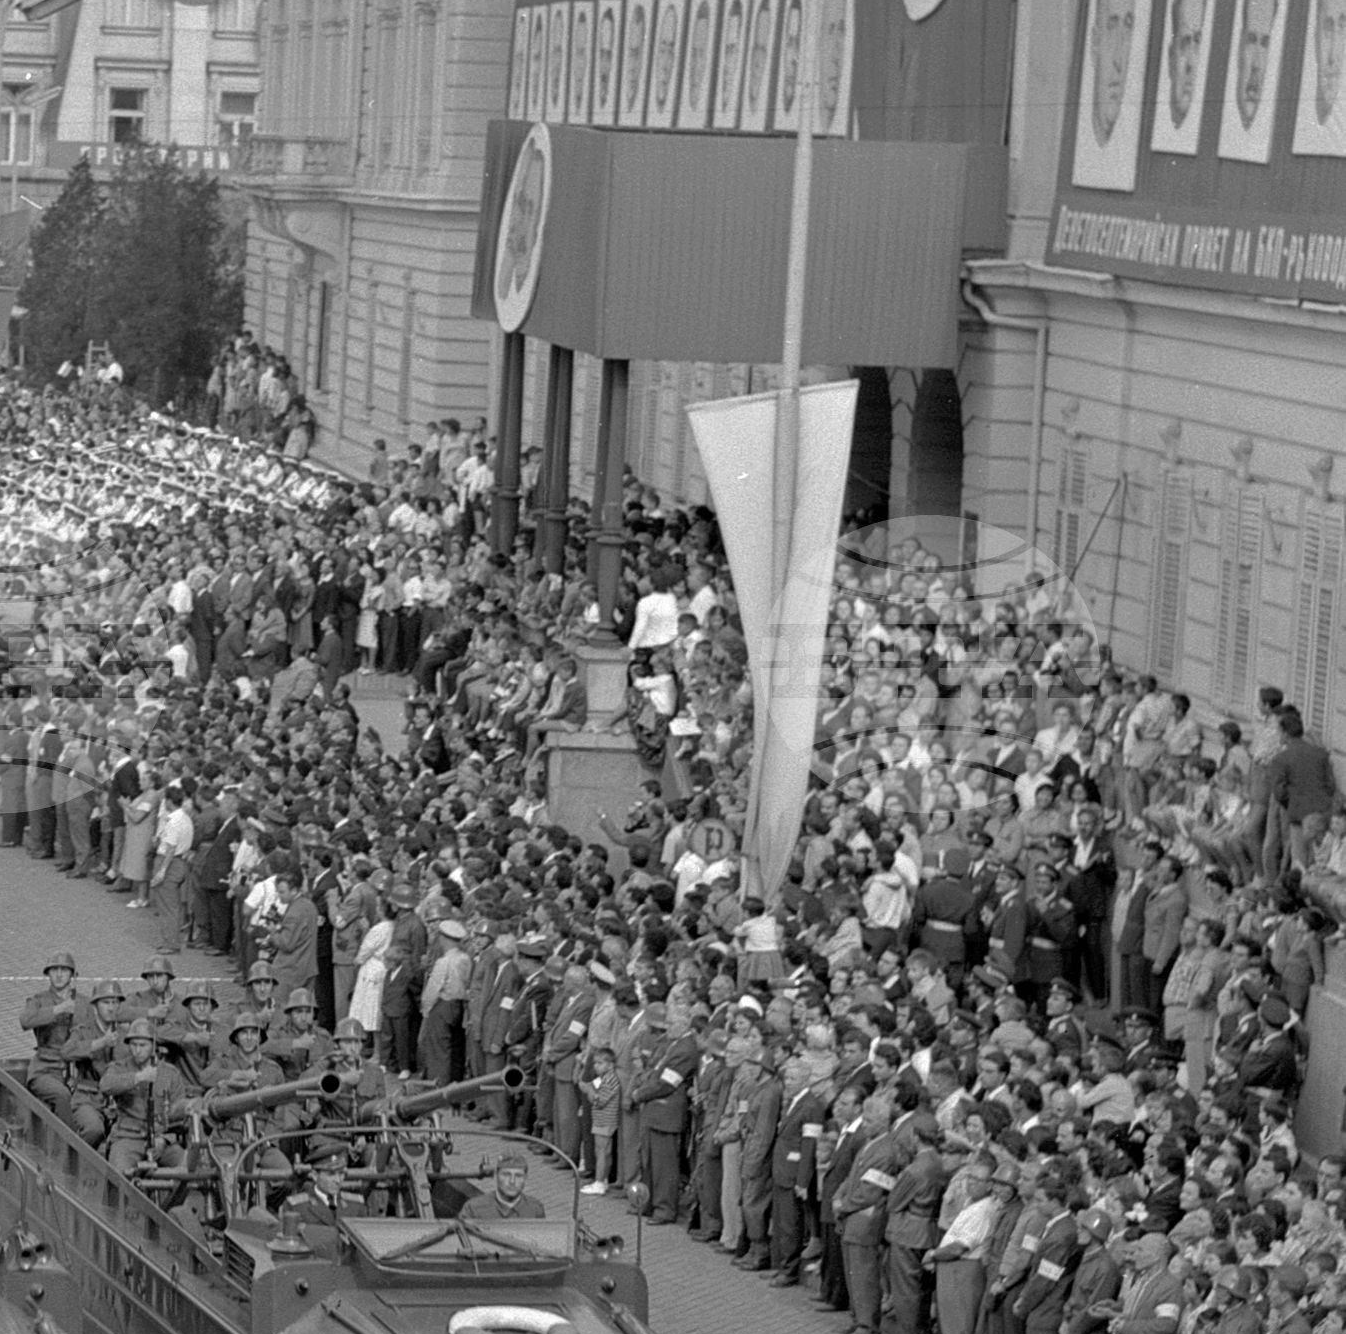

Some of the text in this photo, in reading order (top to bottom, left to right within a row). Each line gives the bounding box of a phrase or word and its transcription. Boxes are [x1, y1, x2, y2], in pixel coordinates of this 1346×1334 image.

[80, 145, 230, 170] ПРОТАРИИ
[1181, 223, 1230, 273] ПРИВЕТ
[1231, 228, 1251, 275] НА
